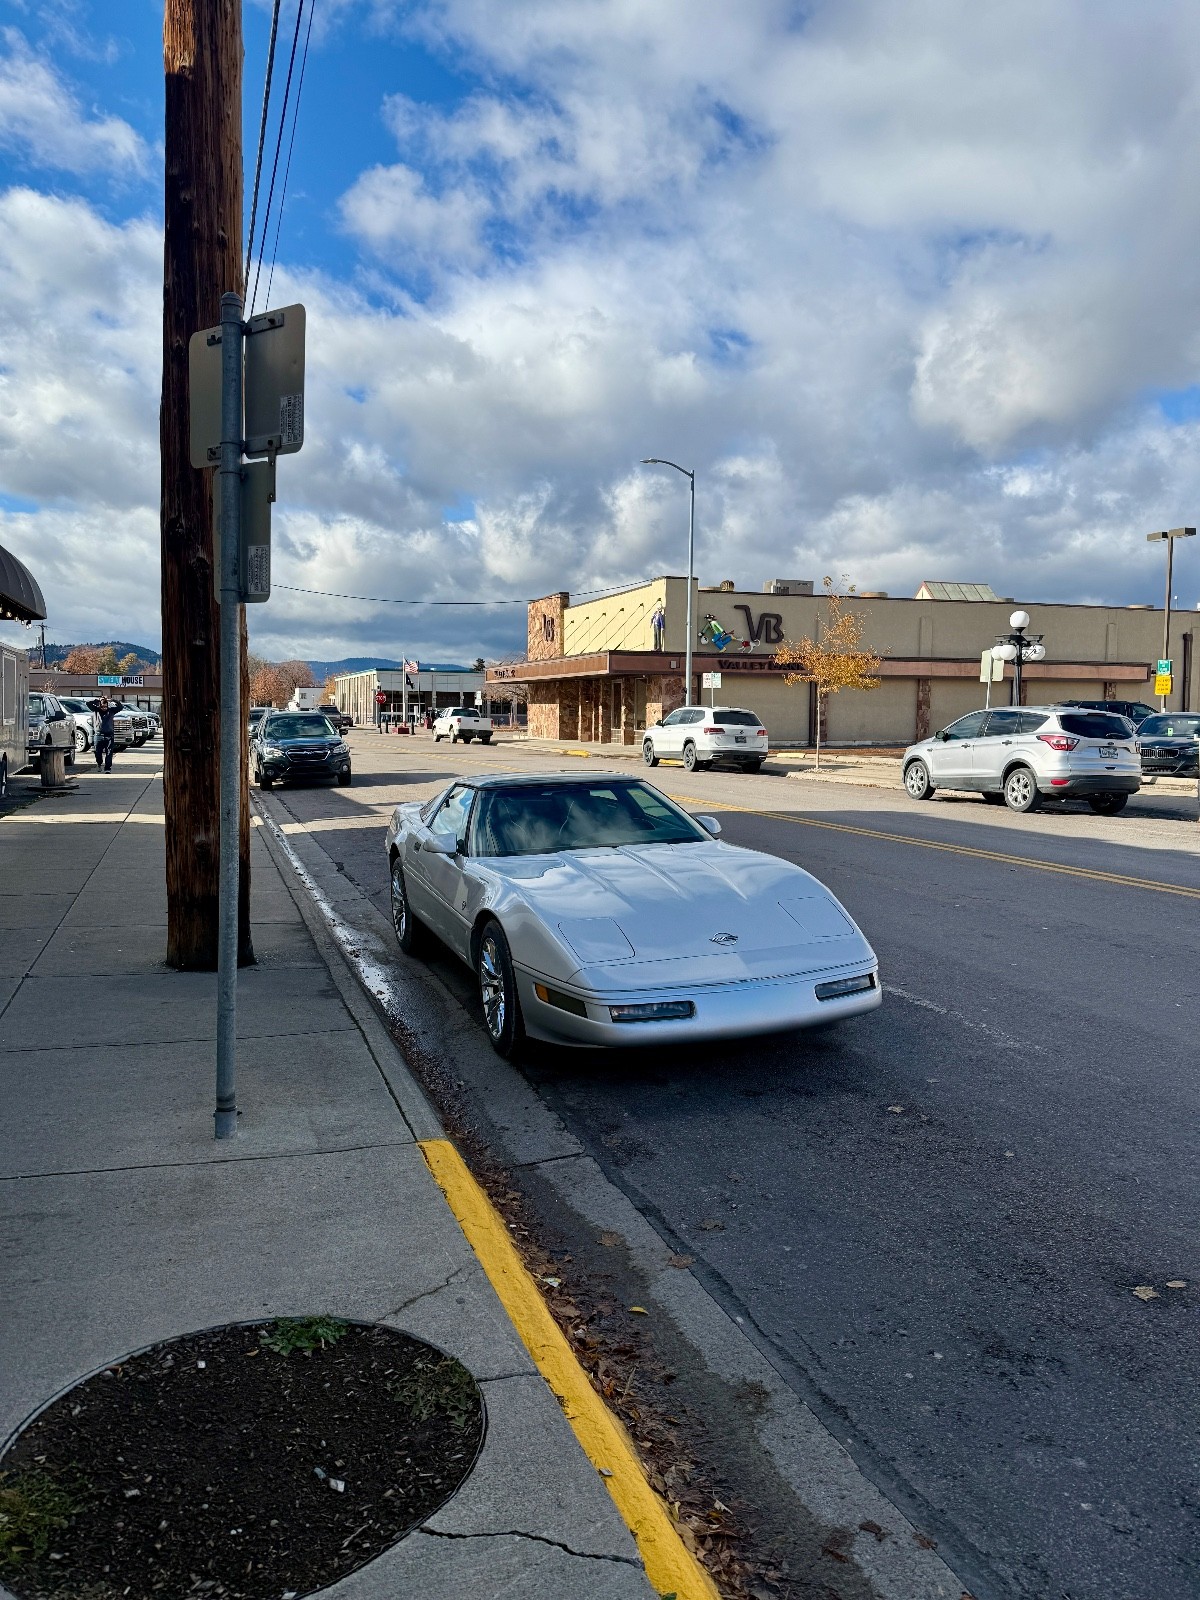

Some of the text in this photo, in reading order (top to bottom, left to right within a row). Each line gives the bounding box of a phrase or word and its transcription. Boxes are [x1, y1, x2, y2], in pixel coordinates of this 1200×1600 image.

[733, 604, 784, 643] VB
[717, 659, 767, 670] VALLEY
[122, 677, 142, 685] HOUSE
